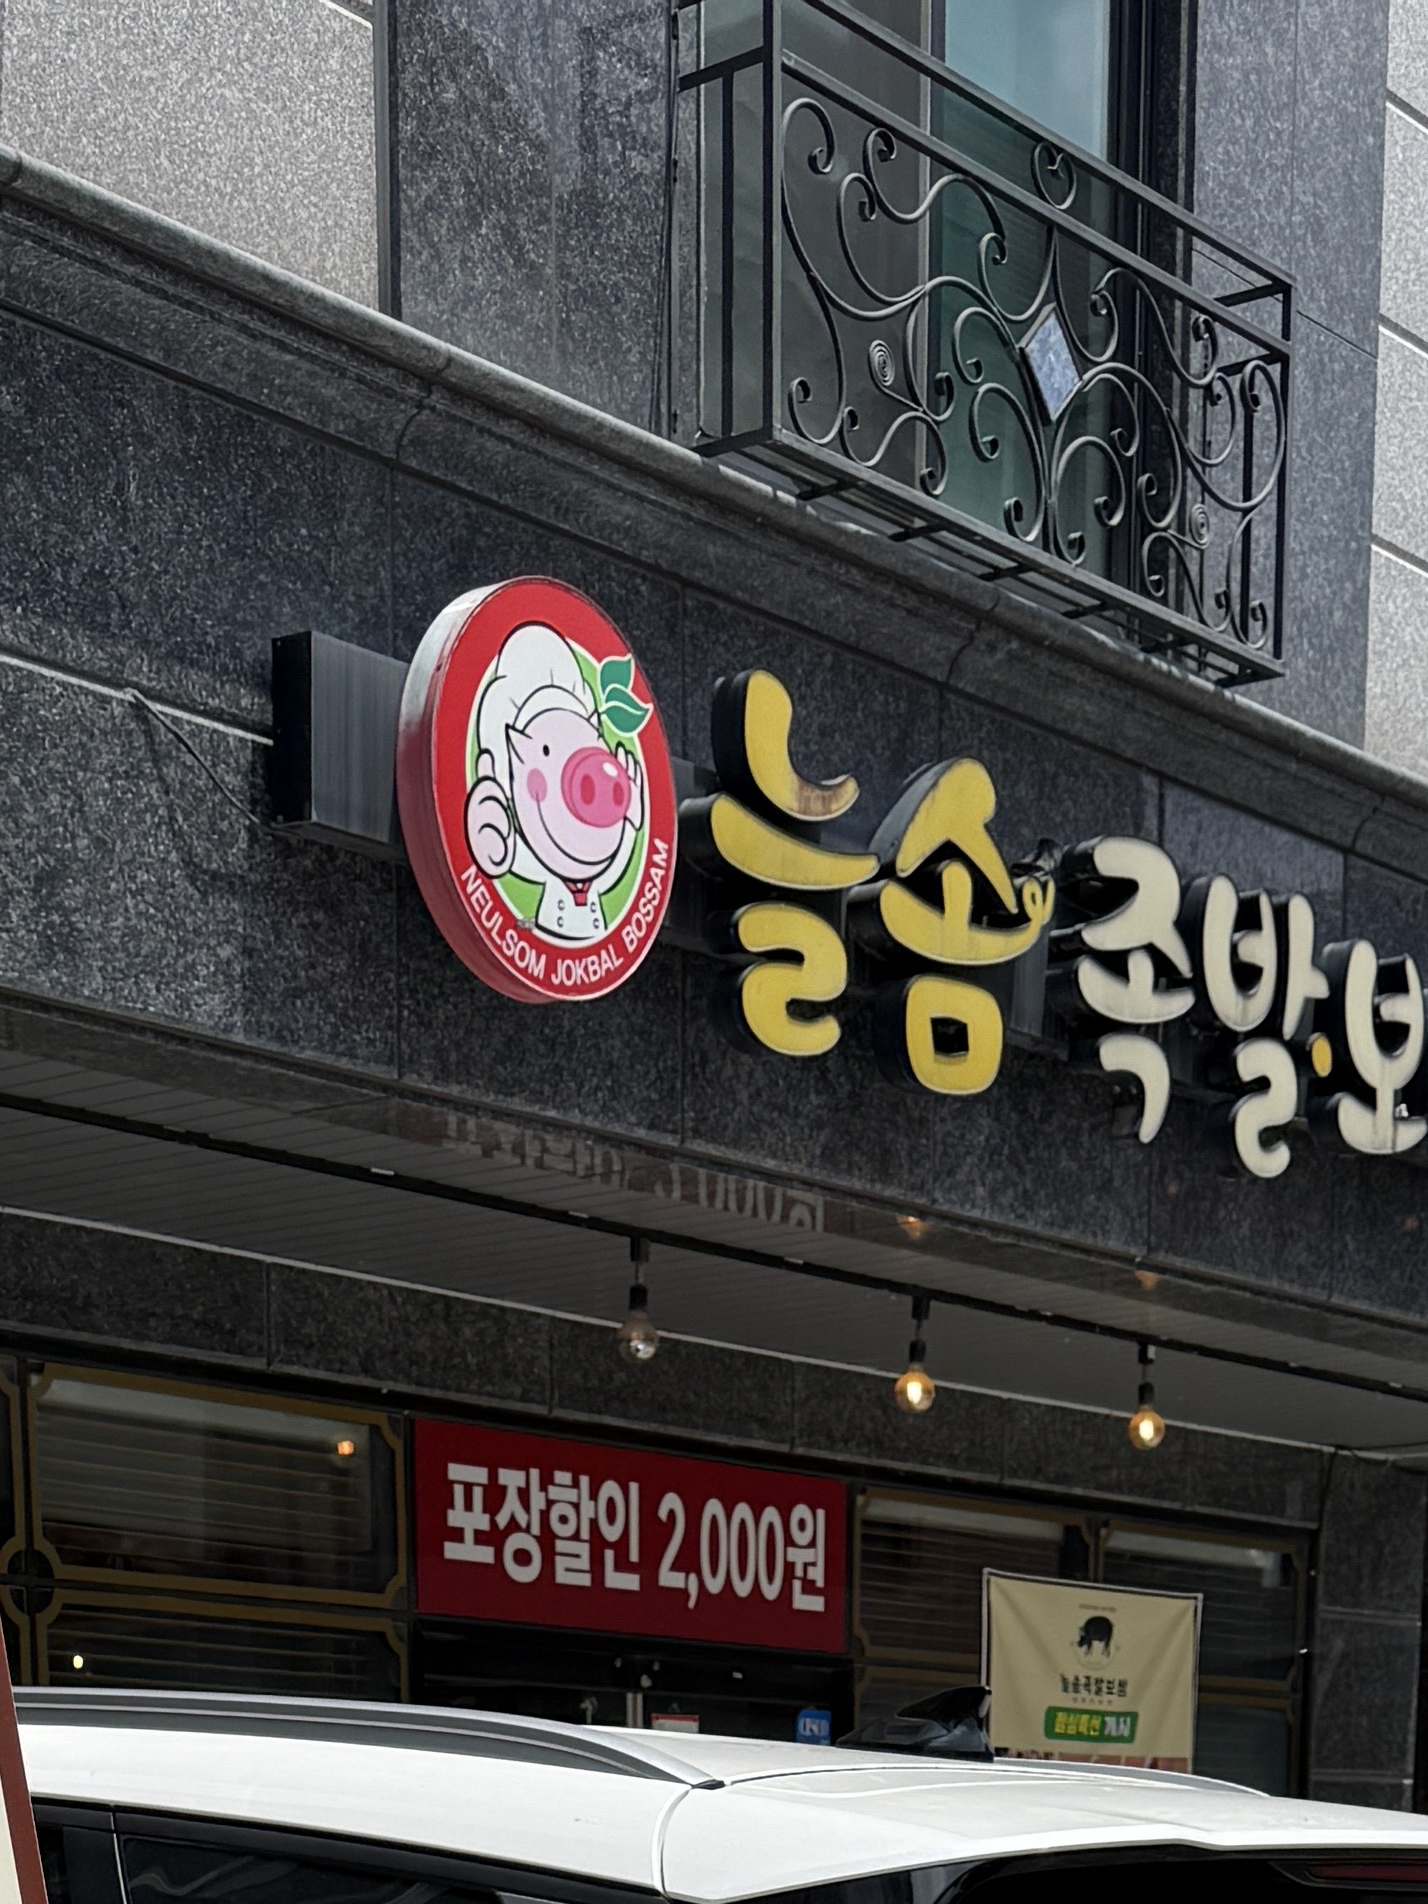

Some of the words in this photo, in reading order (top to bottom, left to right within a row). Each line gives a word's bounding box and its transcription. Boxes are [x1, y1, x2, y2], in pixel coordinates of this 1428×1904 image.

[460, 865, 546, 981] NEULSOM
[551, 952, 624, 987] JOKBAL
[626, 838, 670, 954] BOSSAM
[711, 670, 1054, 1095] 늘솜
[443, 1462, 640, 1590] 포장할인
[657, 1492, 825, 1612] 2,000원
